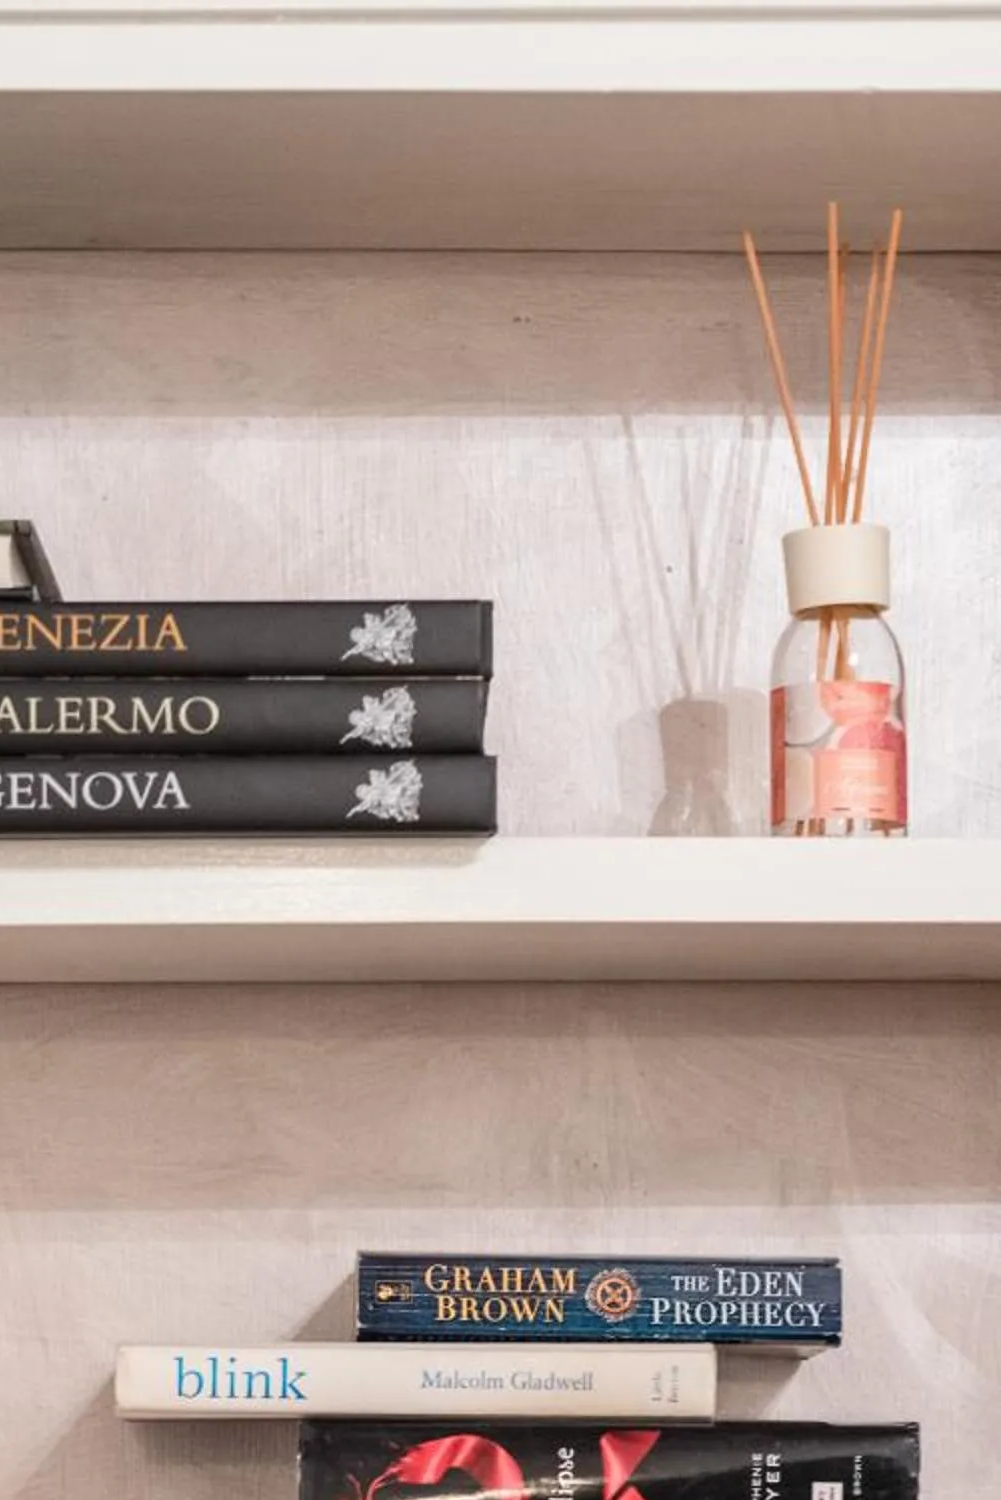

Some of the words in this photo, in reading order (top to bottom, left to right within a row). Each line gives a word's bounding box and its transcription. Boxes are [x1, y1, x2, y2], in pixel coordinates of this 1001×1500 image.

[424, 1264, 577, 1294] GRAHAM
[671, 1275, 709, 1292] THE
[713, 1268, 803, 1297] EDEN
[437, 1297, 565, 1322] BROWN
[650, 1298, 824, 1326] PROPHECY
[174, 1356, 307, 1400] blink
[421, 1370, 504, 1391] Malcolm
[509, 1371, 594, 1391] Gladwell
